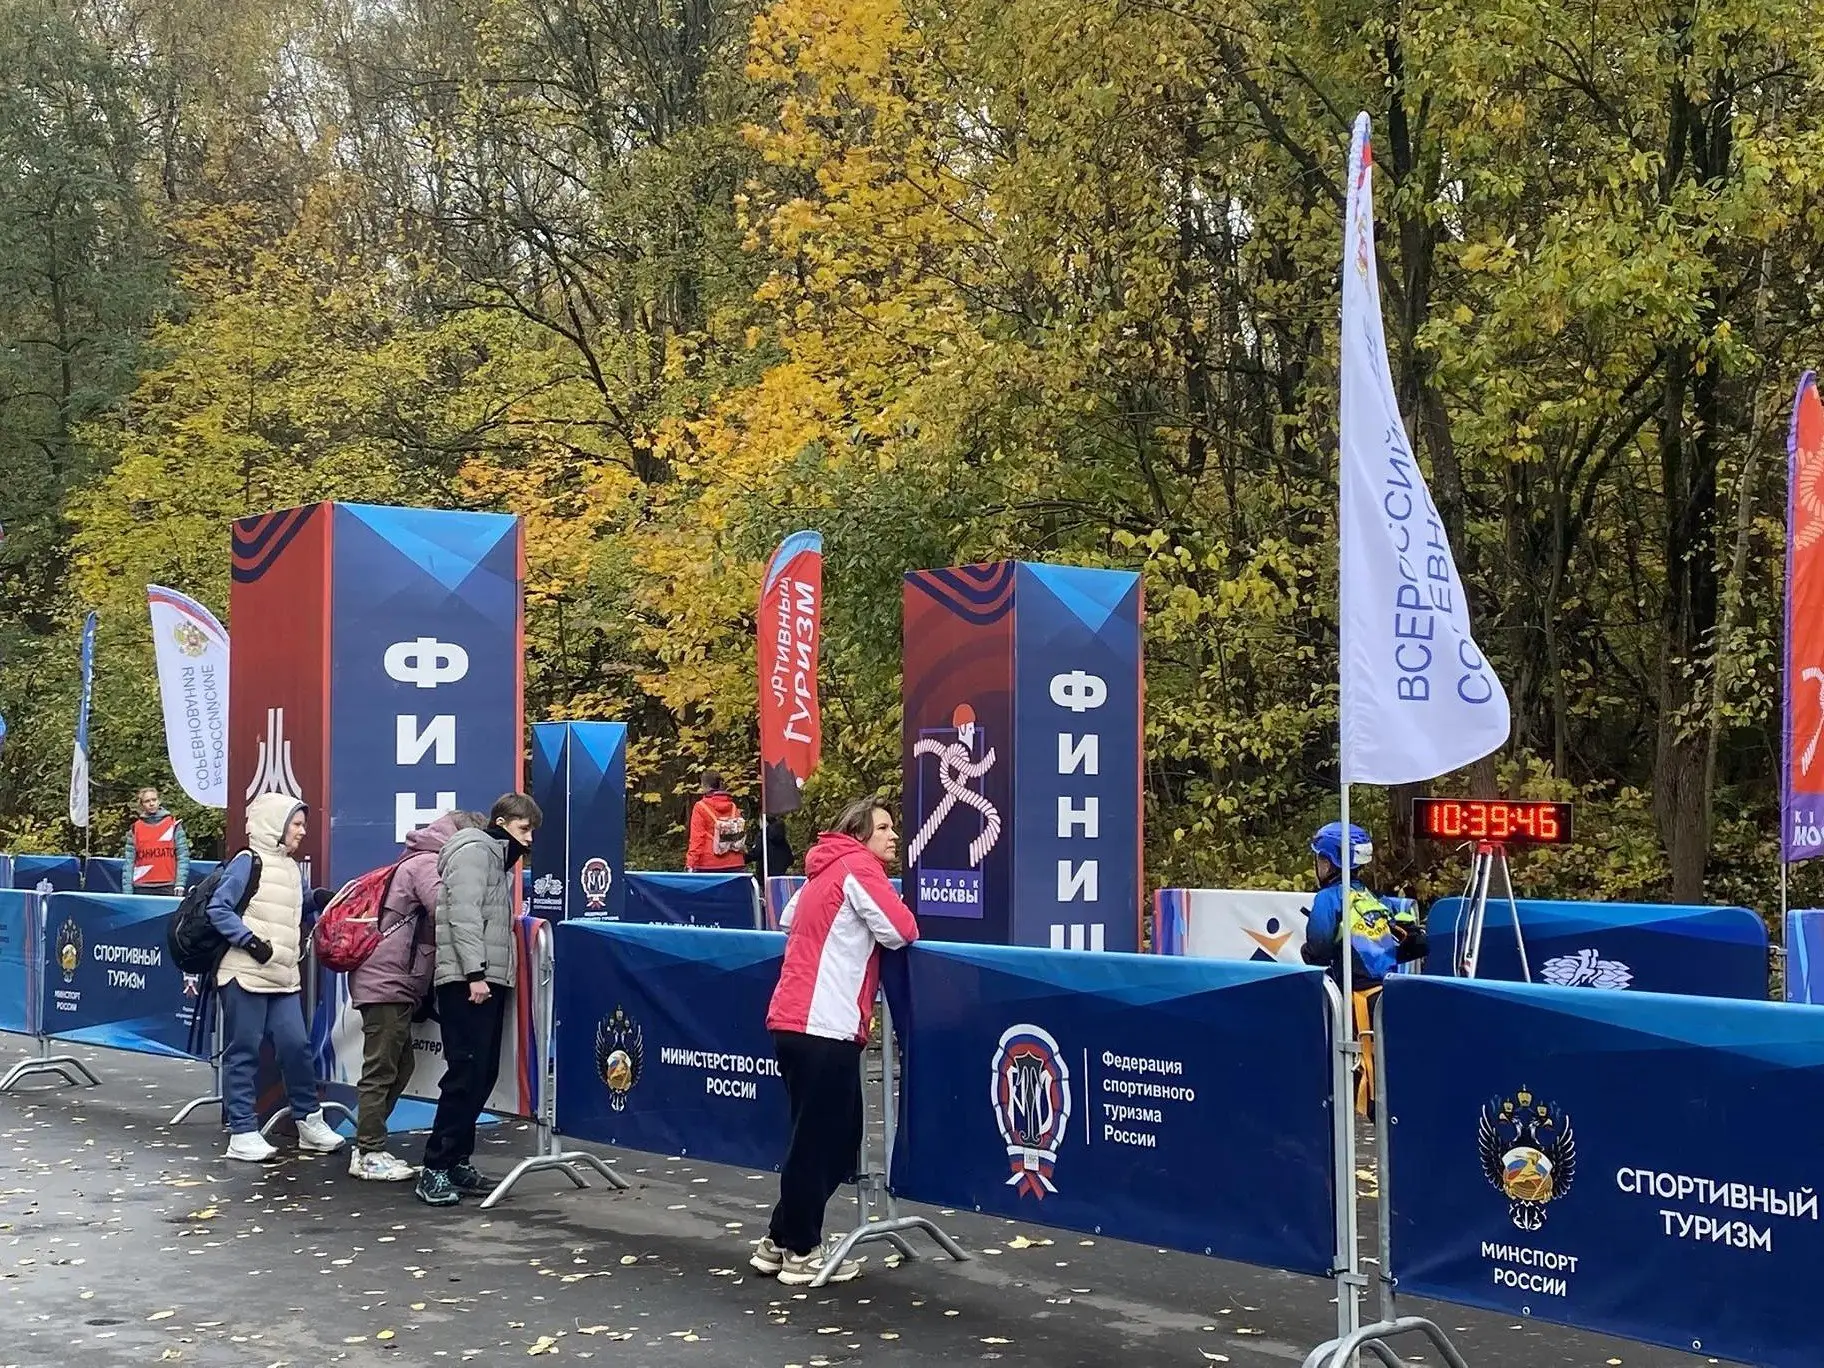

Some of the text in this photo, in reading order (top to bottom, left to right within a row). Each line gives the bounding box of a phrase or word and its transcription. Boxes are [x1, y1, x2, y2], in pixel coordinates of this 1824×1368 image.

[383, 637, 469, 844] ФИН
[1432, 804, 1557, 838] 10:39:46
[921, 878, 979, 888] КУБОК
[921, 887, 979, 904] МОСКВЫ
[94, 944, 161, 966] СПОРТИВНЫЙ
[108, 969, 146, 990] ТУРИЗМ
[412, 1039, 442, 1055] астер
[661, 1047, 782, 1077] МИНИСТЕРСТВО СПО
[1102, 1051, 1182, 1075] Федерация
[706, 1077, 757, 1100] РОССИИ
[1103, 1079, 1195, 1101] спортивного
[1103, 1104, 1162, 1122] туризма
[1105, 1124, 1156, 1147] России
[1616, 1167, 1818, 1220] СПОРТИВНЫЙ
[1660, 1210, 1772, 1252] ТУРИЗМ
[1481, 1241, 1578, 1273] МИНСПОРТ
[1494, 1268, 1566, 1297] РОССИИ
